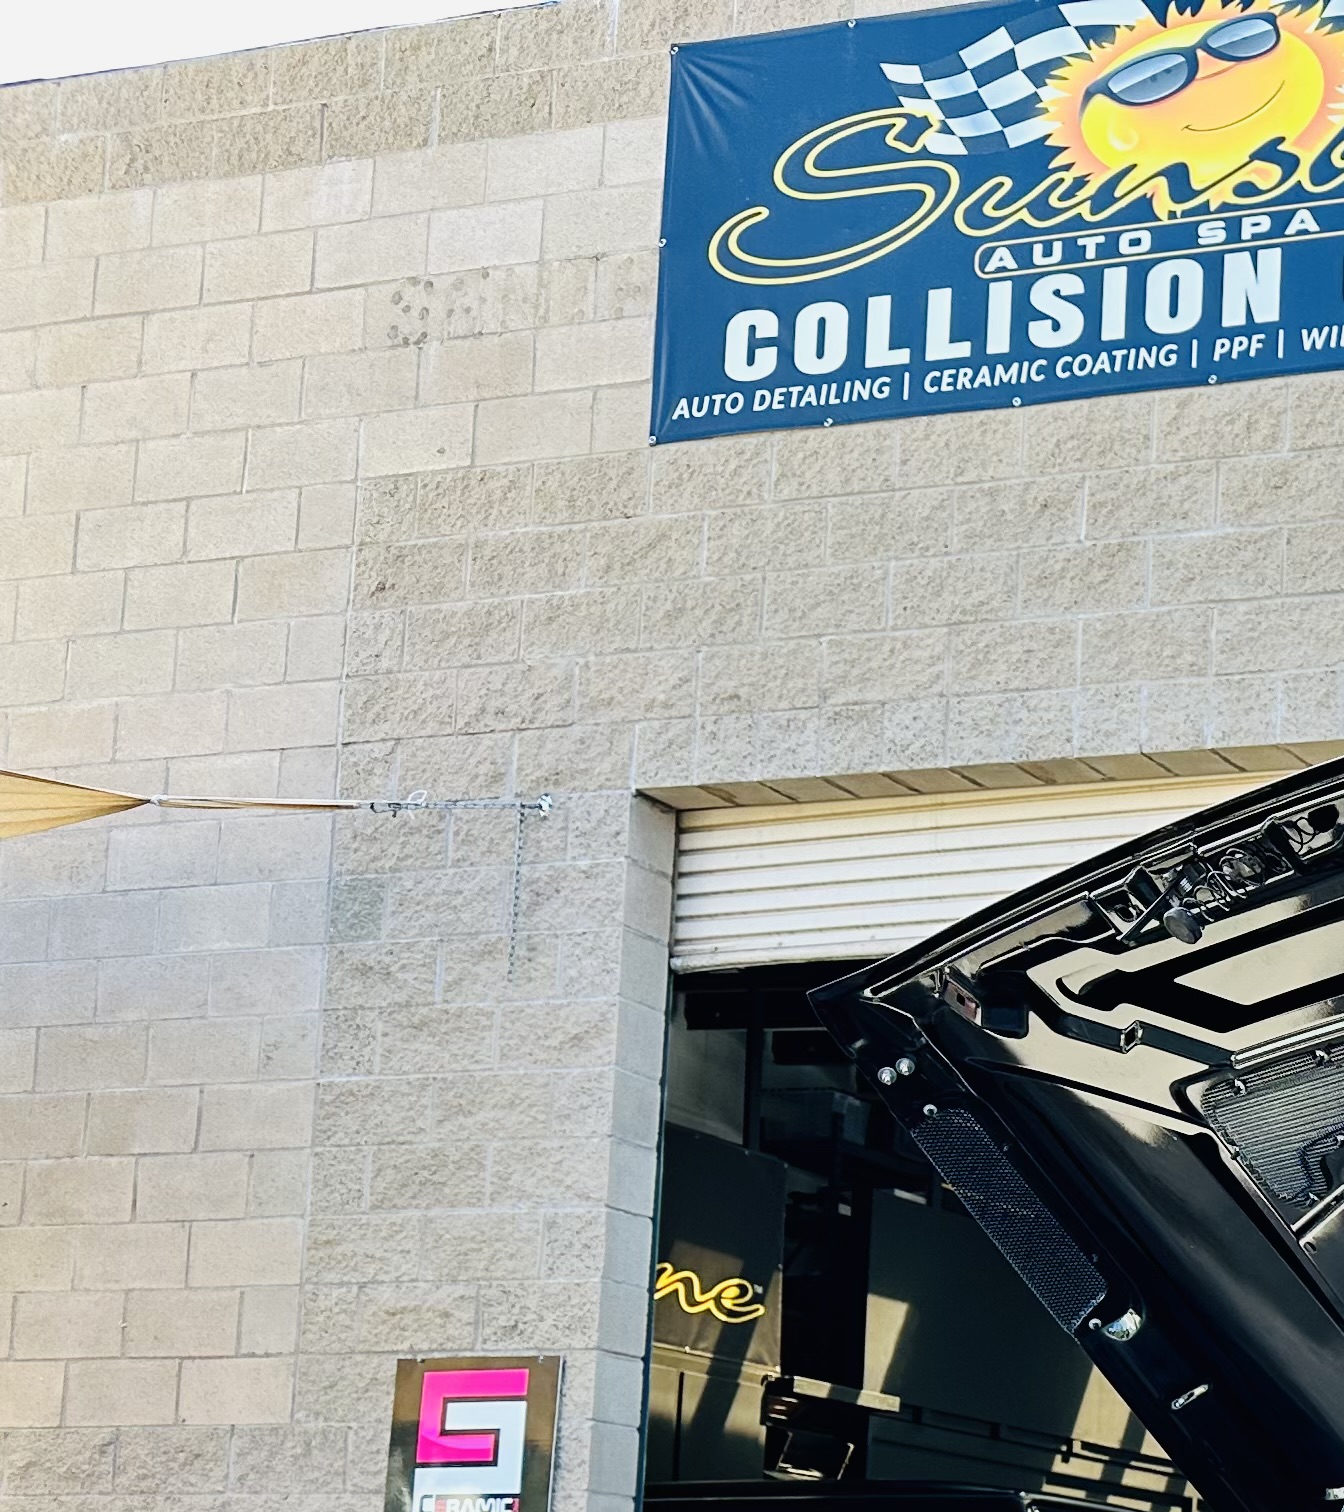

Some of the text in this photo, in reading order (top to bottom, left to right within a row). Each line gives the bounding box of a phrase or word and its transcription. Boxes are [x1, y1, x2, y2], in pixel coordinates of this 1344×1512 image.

[984, 228, 1152, 274] AUTO
[1196, 212, 1320, 246] SPA
[723, 246, 1282, 383] COLLISION
[671, 391, 745, 421] AUTO
[751, 376, 892, 413] DETAILING
[923, 359, 1048, 395] CERAMIC
[1054, 345, 1179, 379] COATING
[1212, 334, 1266, 361] PPF
